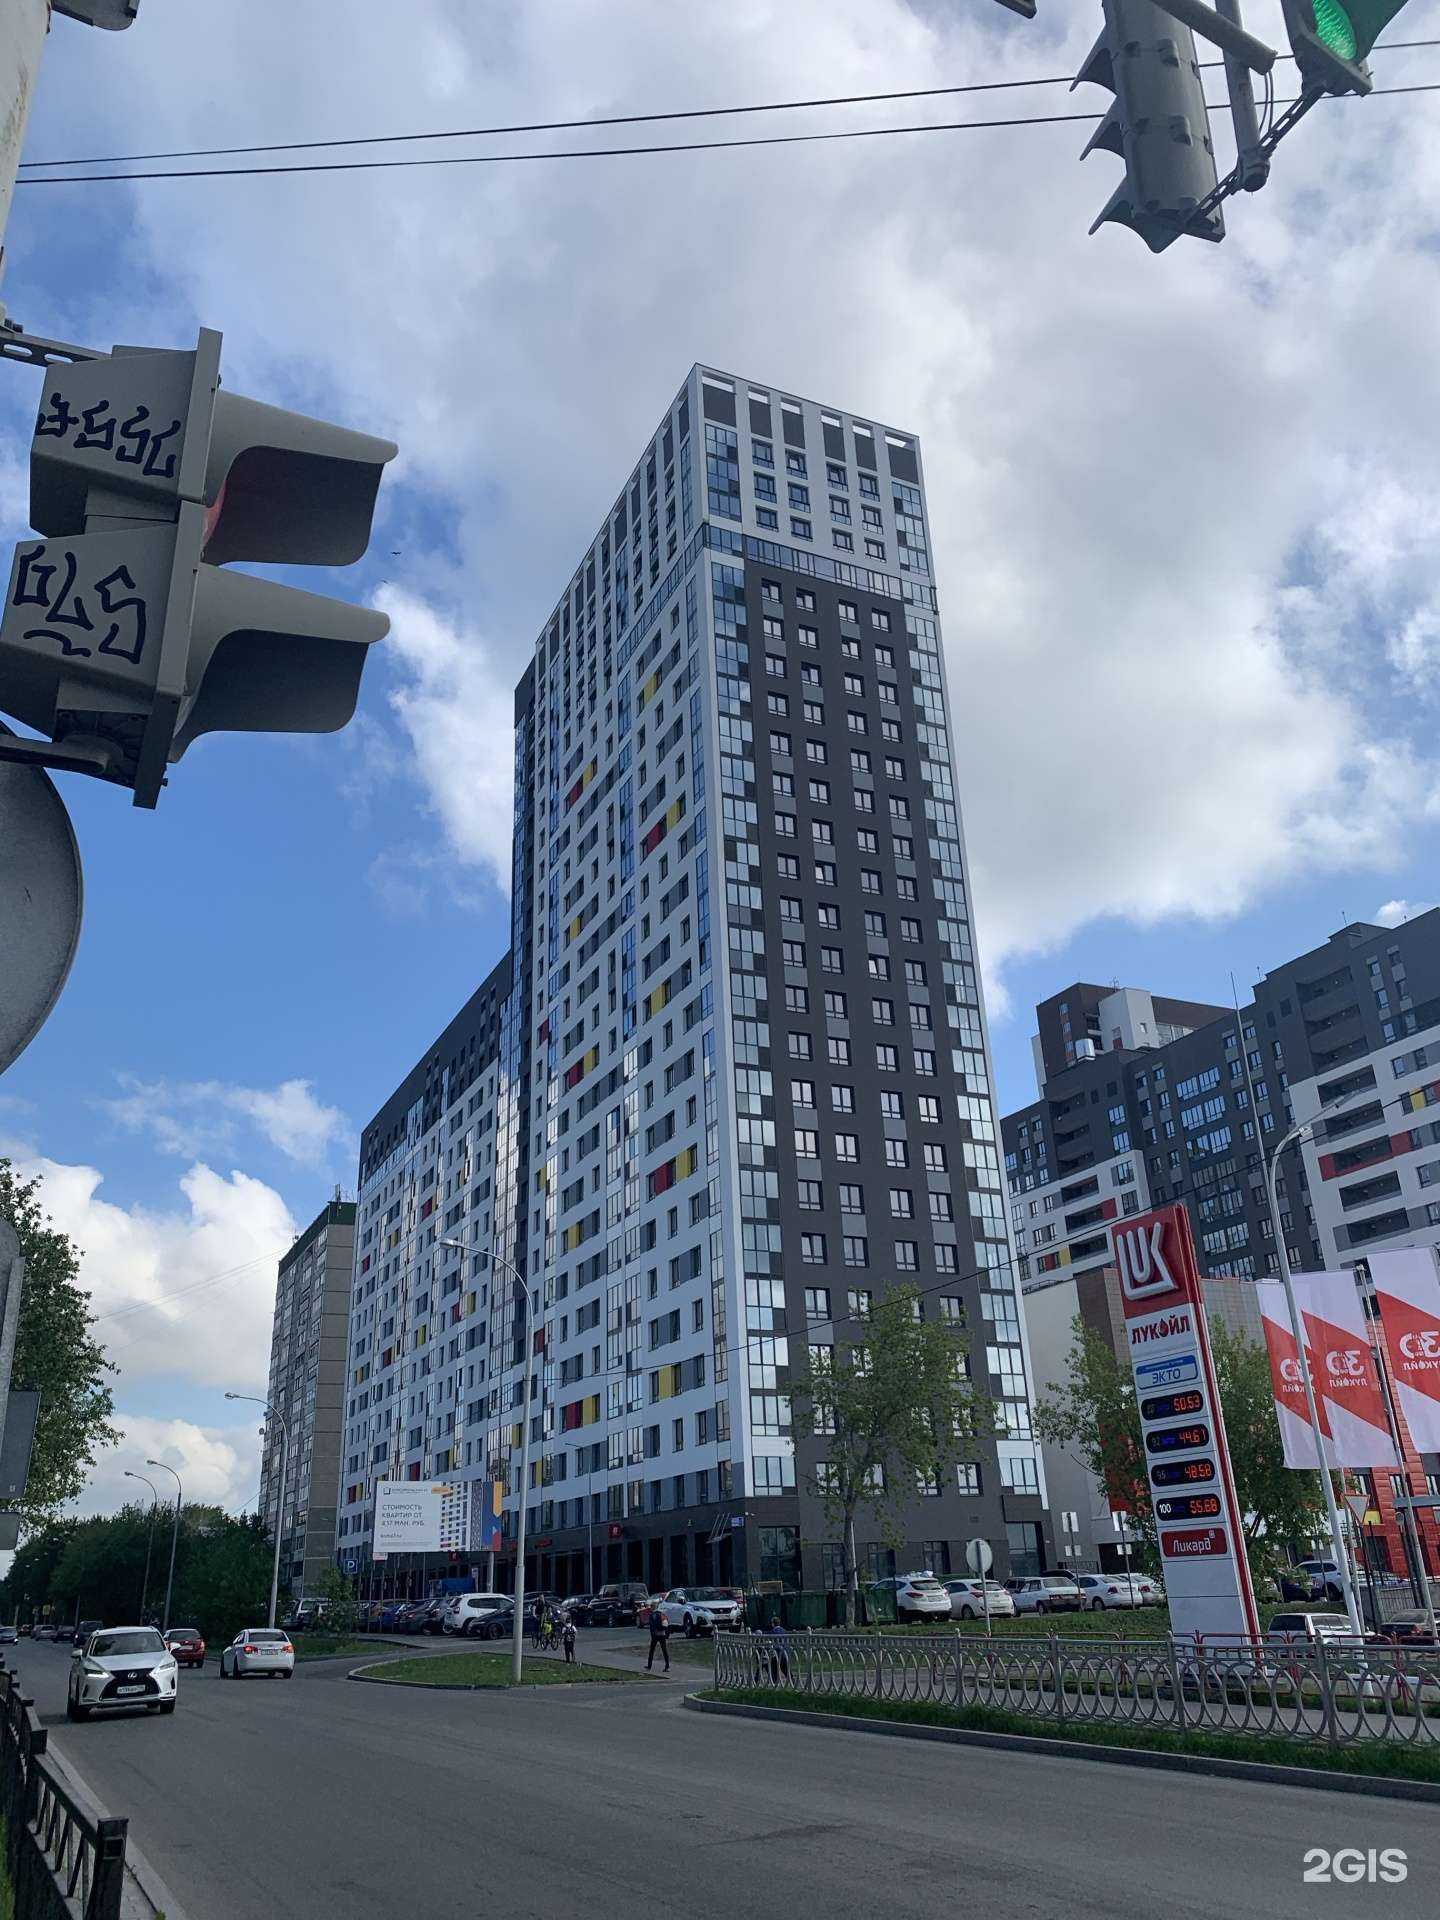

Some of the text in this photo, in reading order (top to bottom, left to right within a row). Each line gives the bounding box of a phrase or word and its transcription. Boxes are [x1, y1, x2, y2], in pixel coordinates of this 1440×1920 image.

[1132, 1314, 1190, 1344] ЛУКОЙЛ
[1152, 1369, 1181, 1385] ЭКТО
[1159, 1503, 1171, 1514] 100
[1174, 1536, 1212, 1554] Ликард
